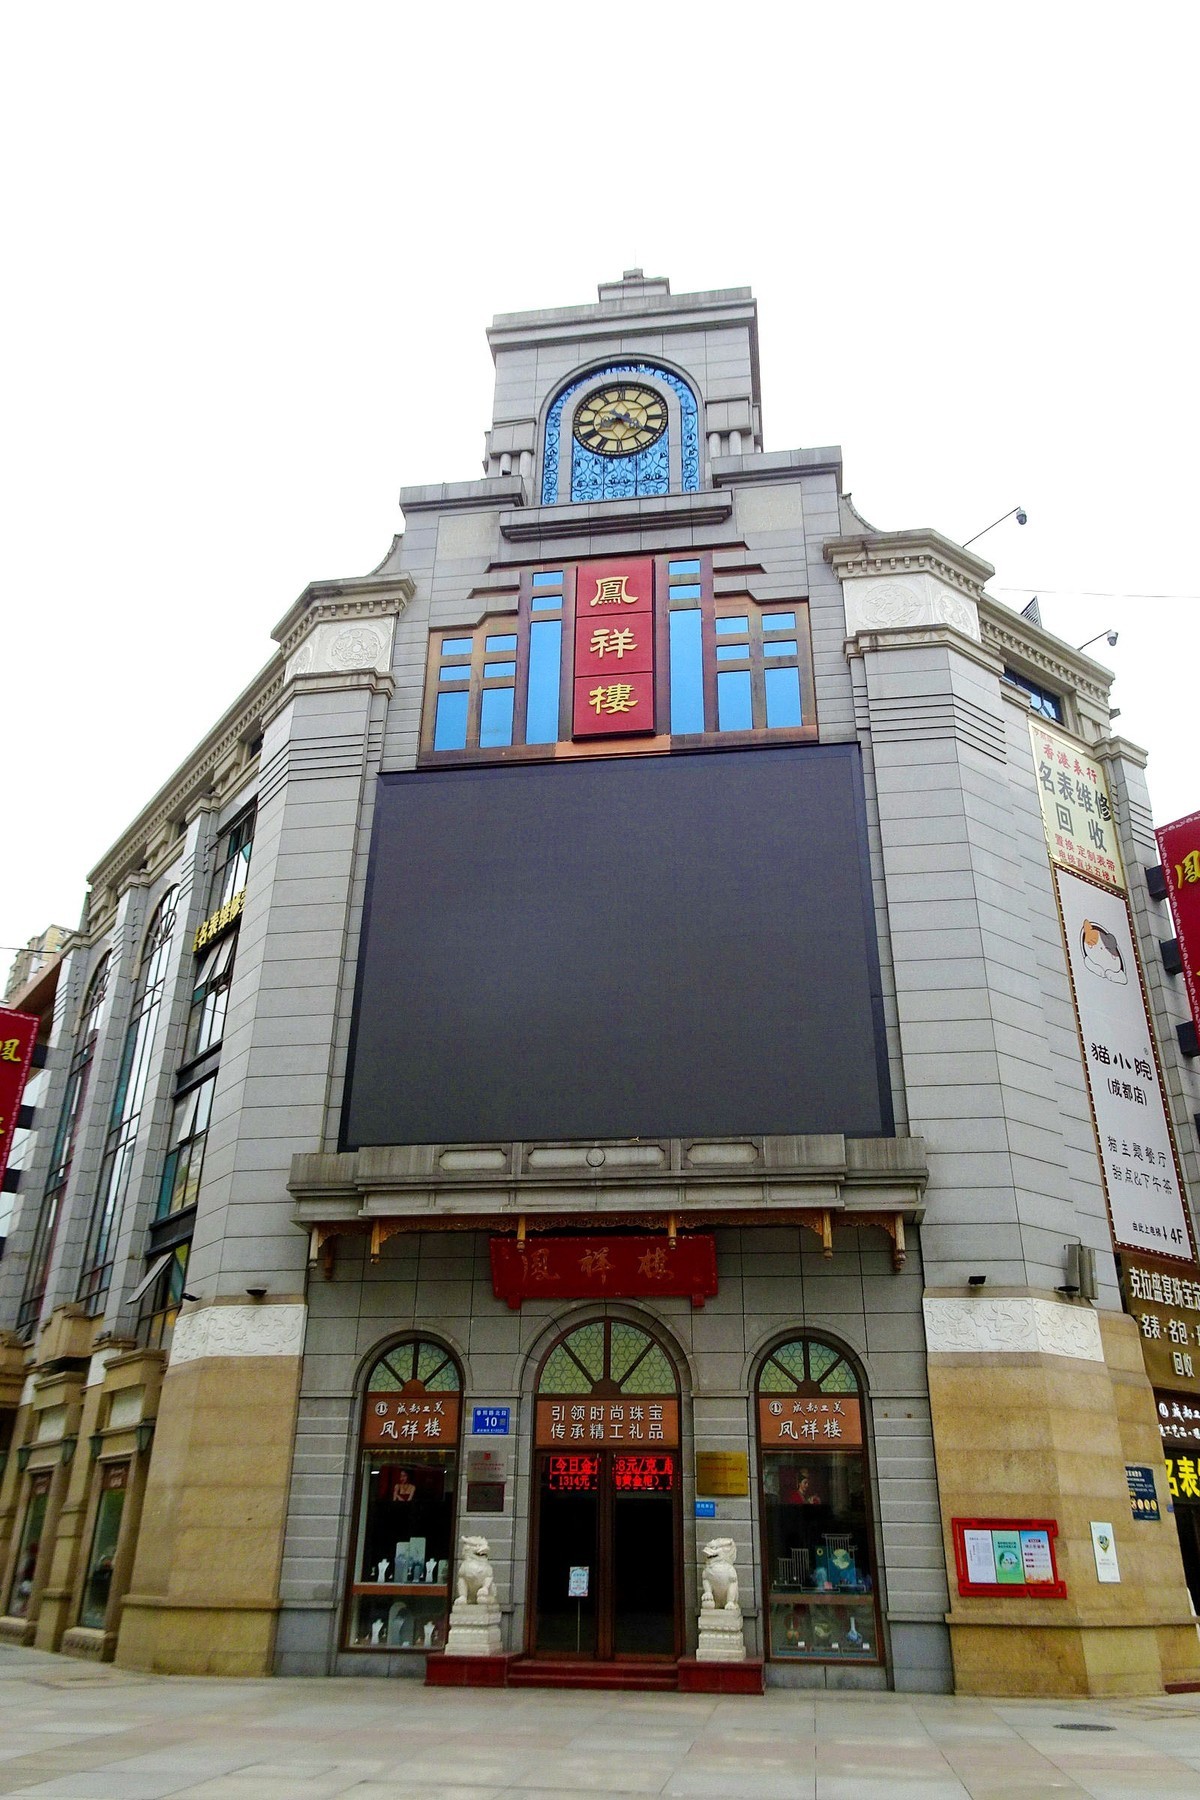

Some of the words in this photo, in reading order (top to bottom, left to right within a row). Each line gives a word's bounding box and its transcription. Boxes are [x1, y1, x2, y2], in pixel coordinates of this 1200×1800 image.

[589, 576, 639, 715] 鳳祥樓
[1043, 744, 1098, 785] 香港表行
[1039, 760, 1111, 822] 名表维修
[1055, 802, 1107, 853] 回收
[1091, 1042, 1153, 1082] 猫小院
[1107, 1135, 1167, 1169] 猫主题餐厅
[1112, 1163, 1173, 1195] 甜点&下午茶
[1170, 1228, 1184, 1245] 4F
[1173, 1350, 1195, 1378] 回收
[397, 1401, 446, 1416] 成都工美
[551, 1404, 663, 1421] 引领时尚珠宝
[792, 1400, 846, 1416] 成都工美
[380, 1417, 442, 1441] 凤祥楼
[485, 1416, 498, 1427] 10
[550, 1423, 664, 1439] 传承精工礼品
[778, 1417, 843, 1441] 凤祥楼
